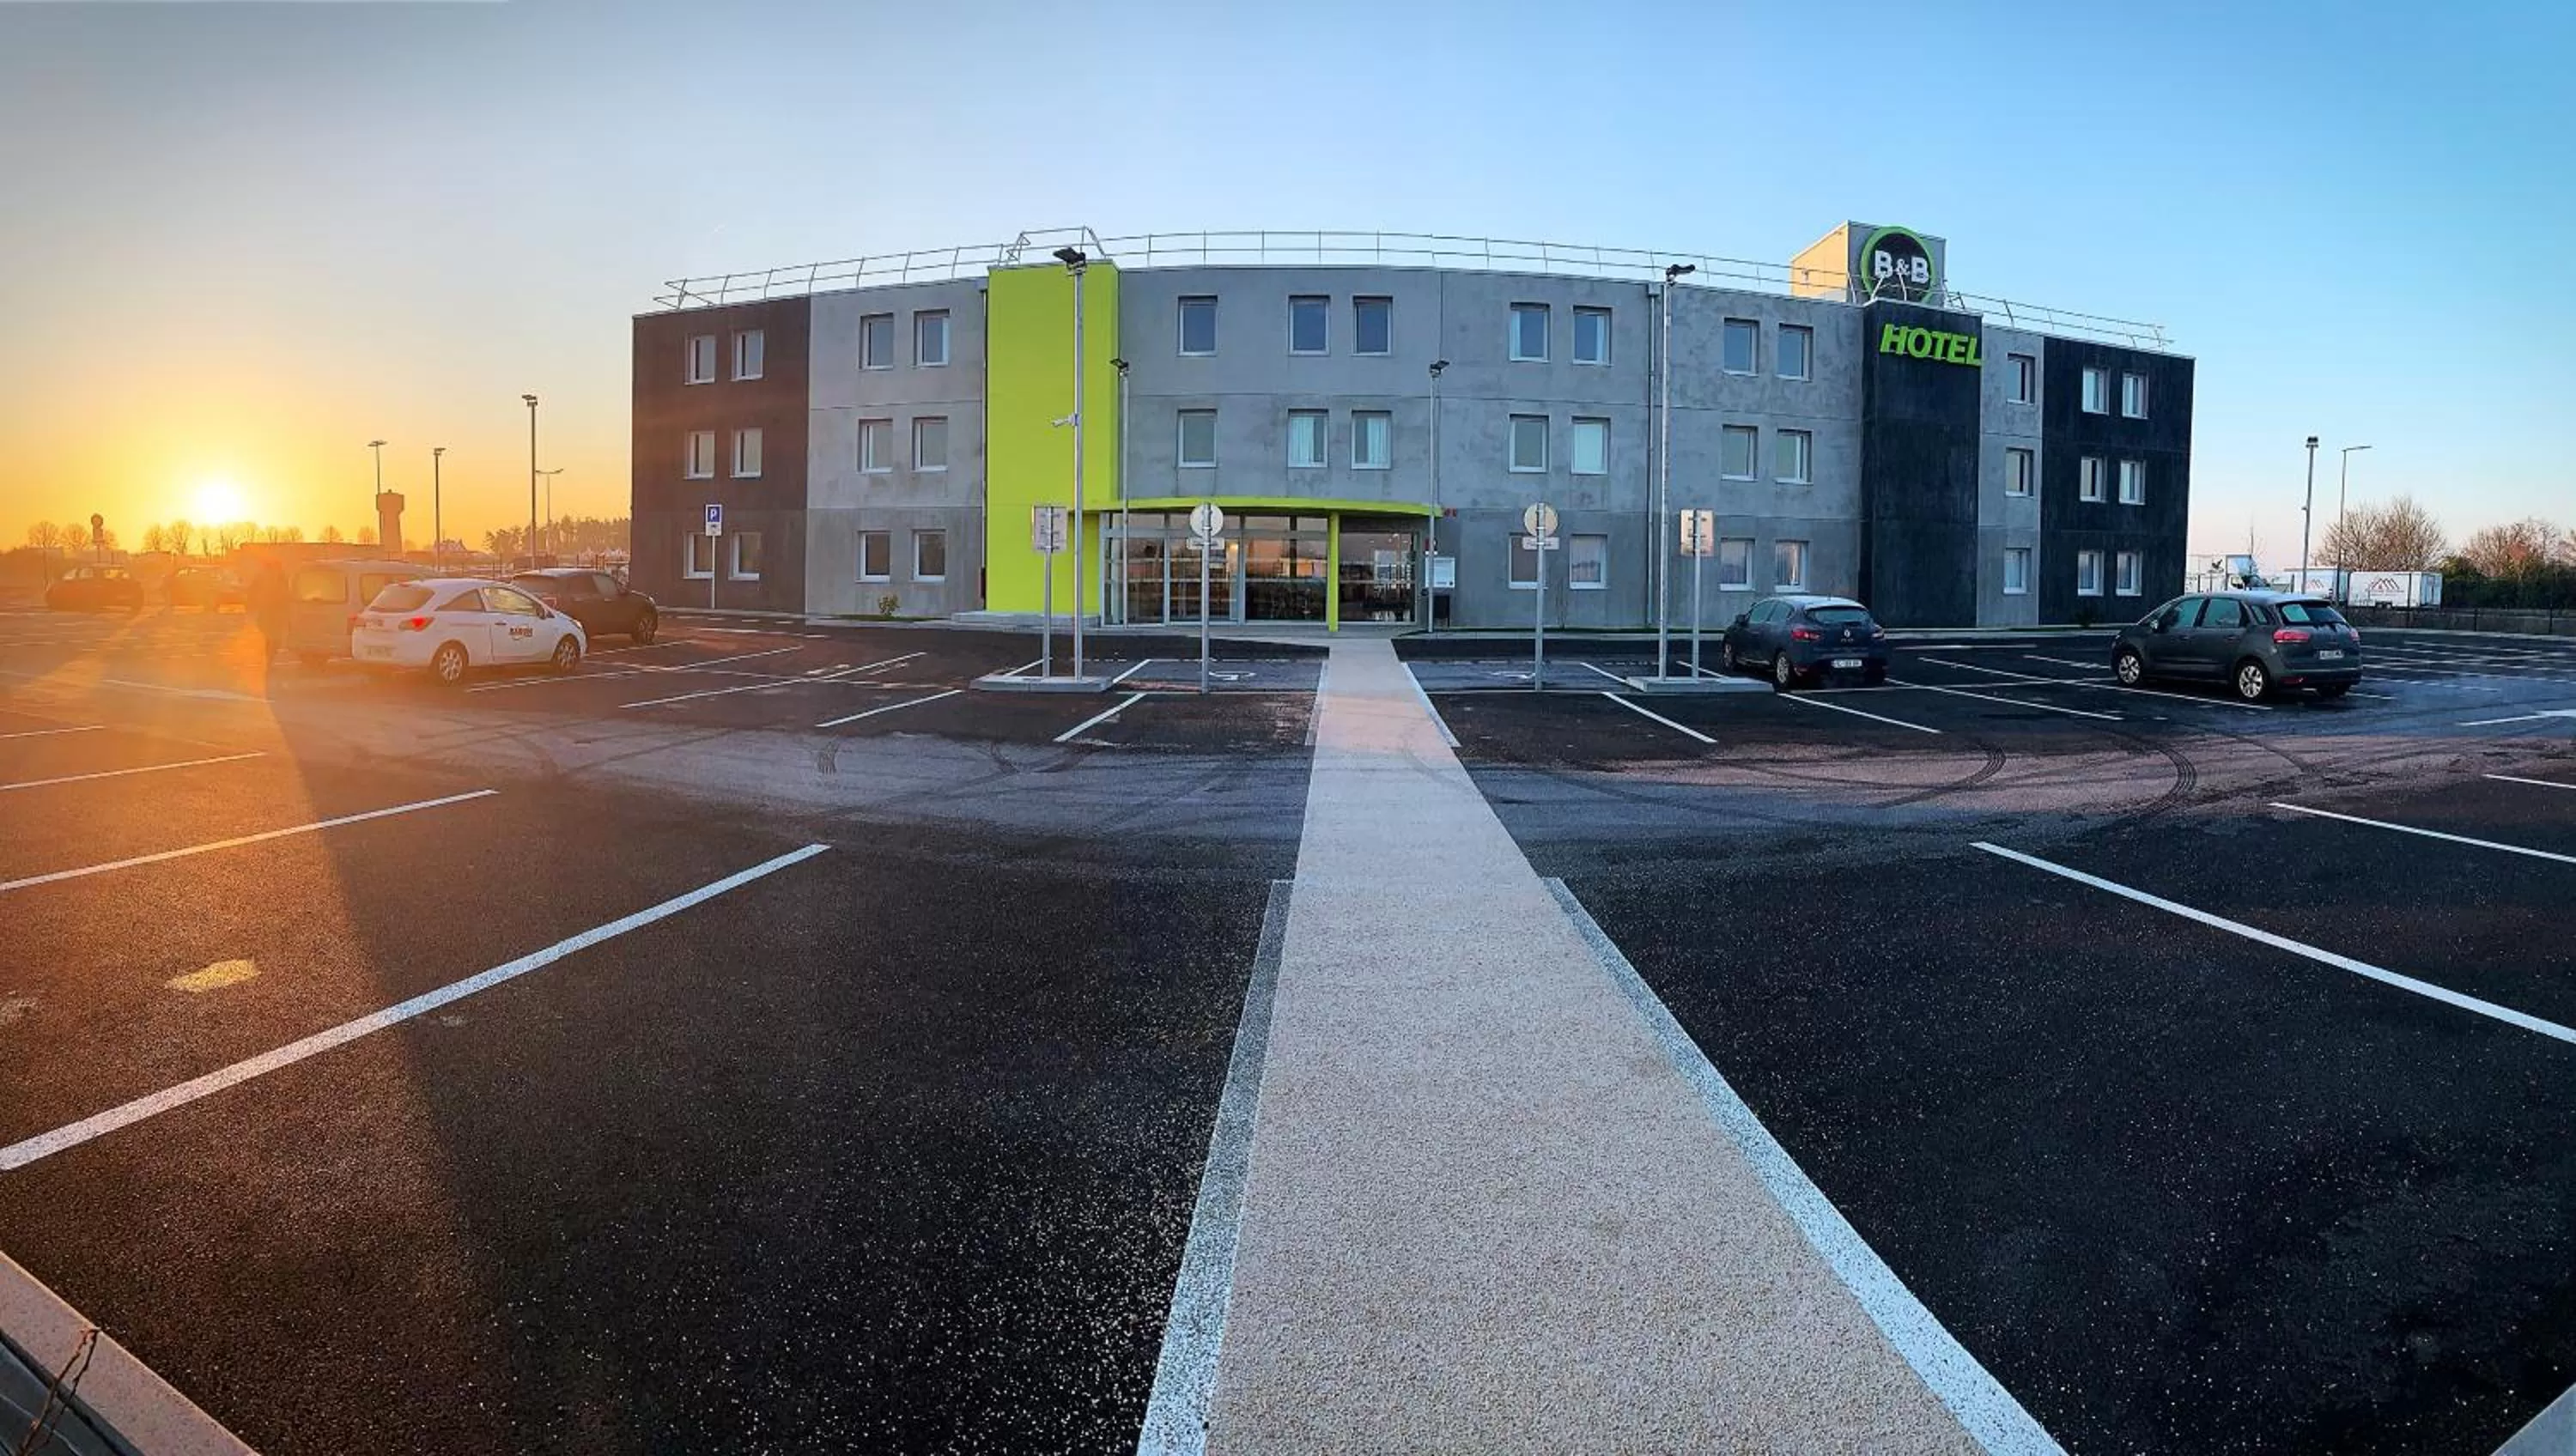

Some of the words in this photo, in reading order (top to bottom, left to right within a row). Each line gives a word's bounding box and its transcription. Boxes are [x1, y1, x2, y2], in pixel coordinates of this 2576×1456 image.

[1874, 250, 1929, 283] B&B
[1880, 324, 1982, 367] HOTEL
[709, 507, 718, 520] P
